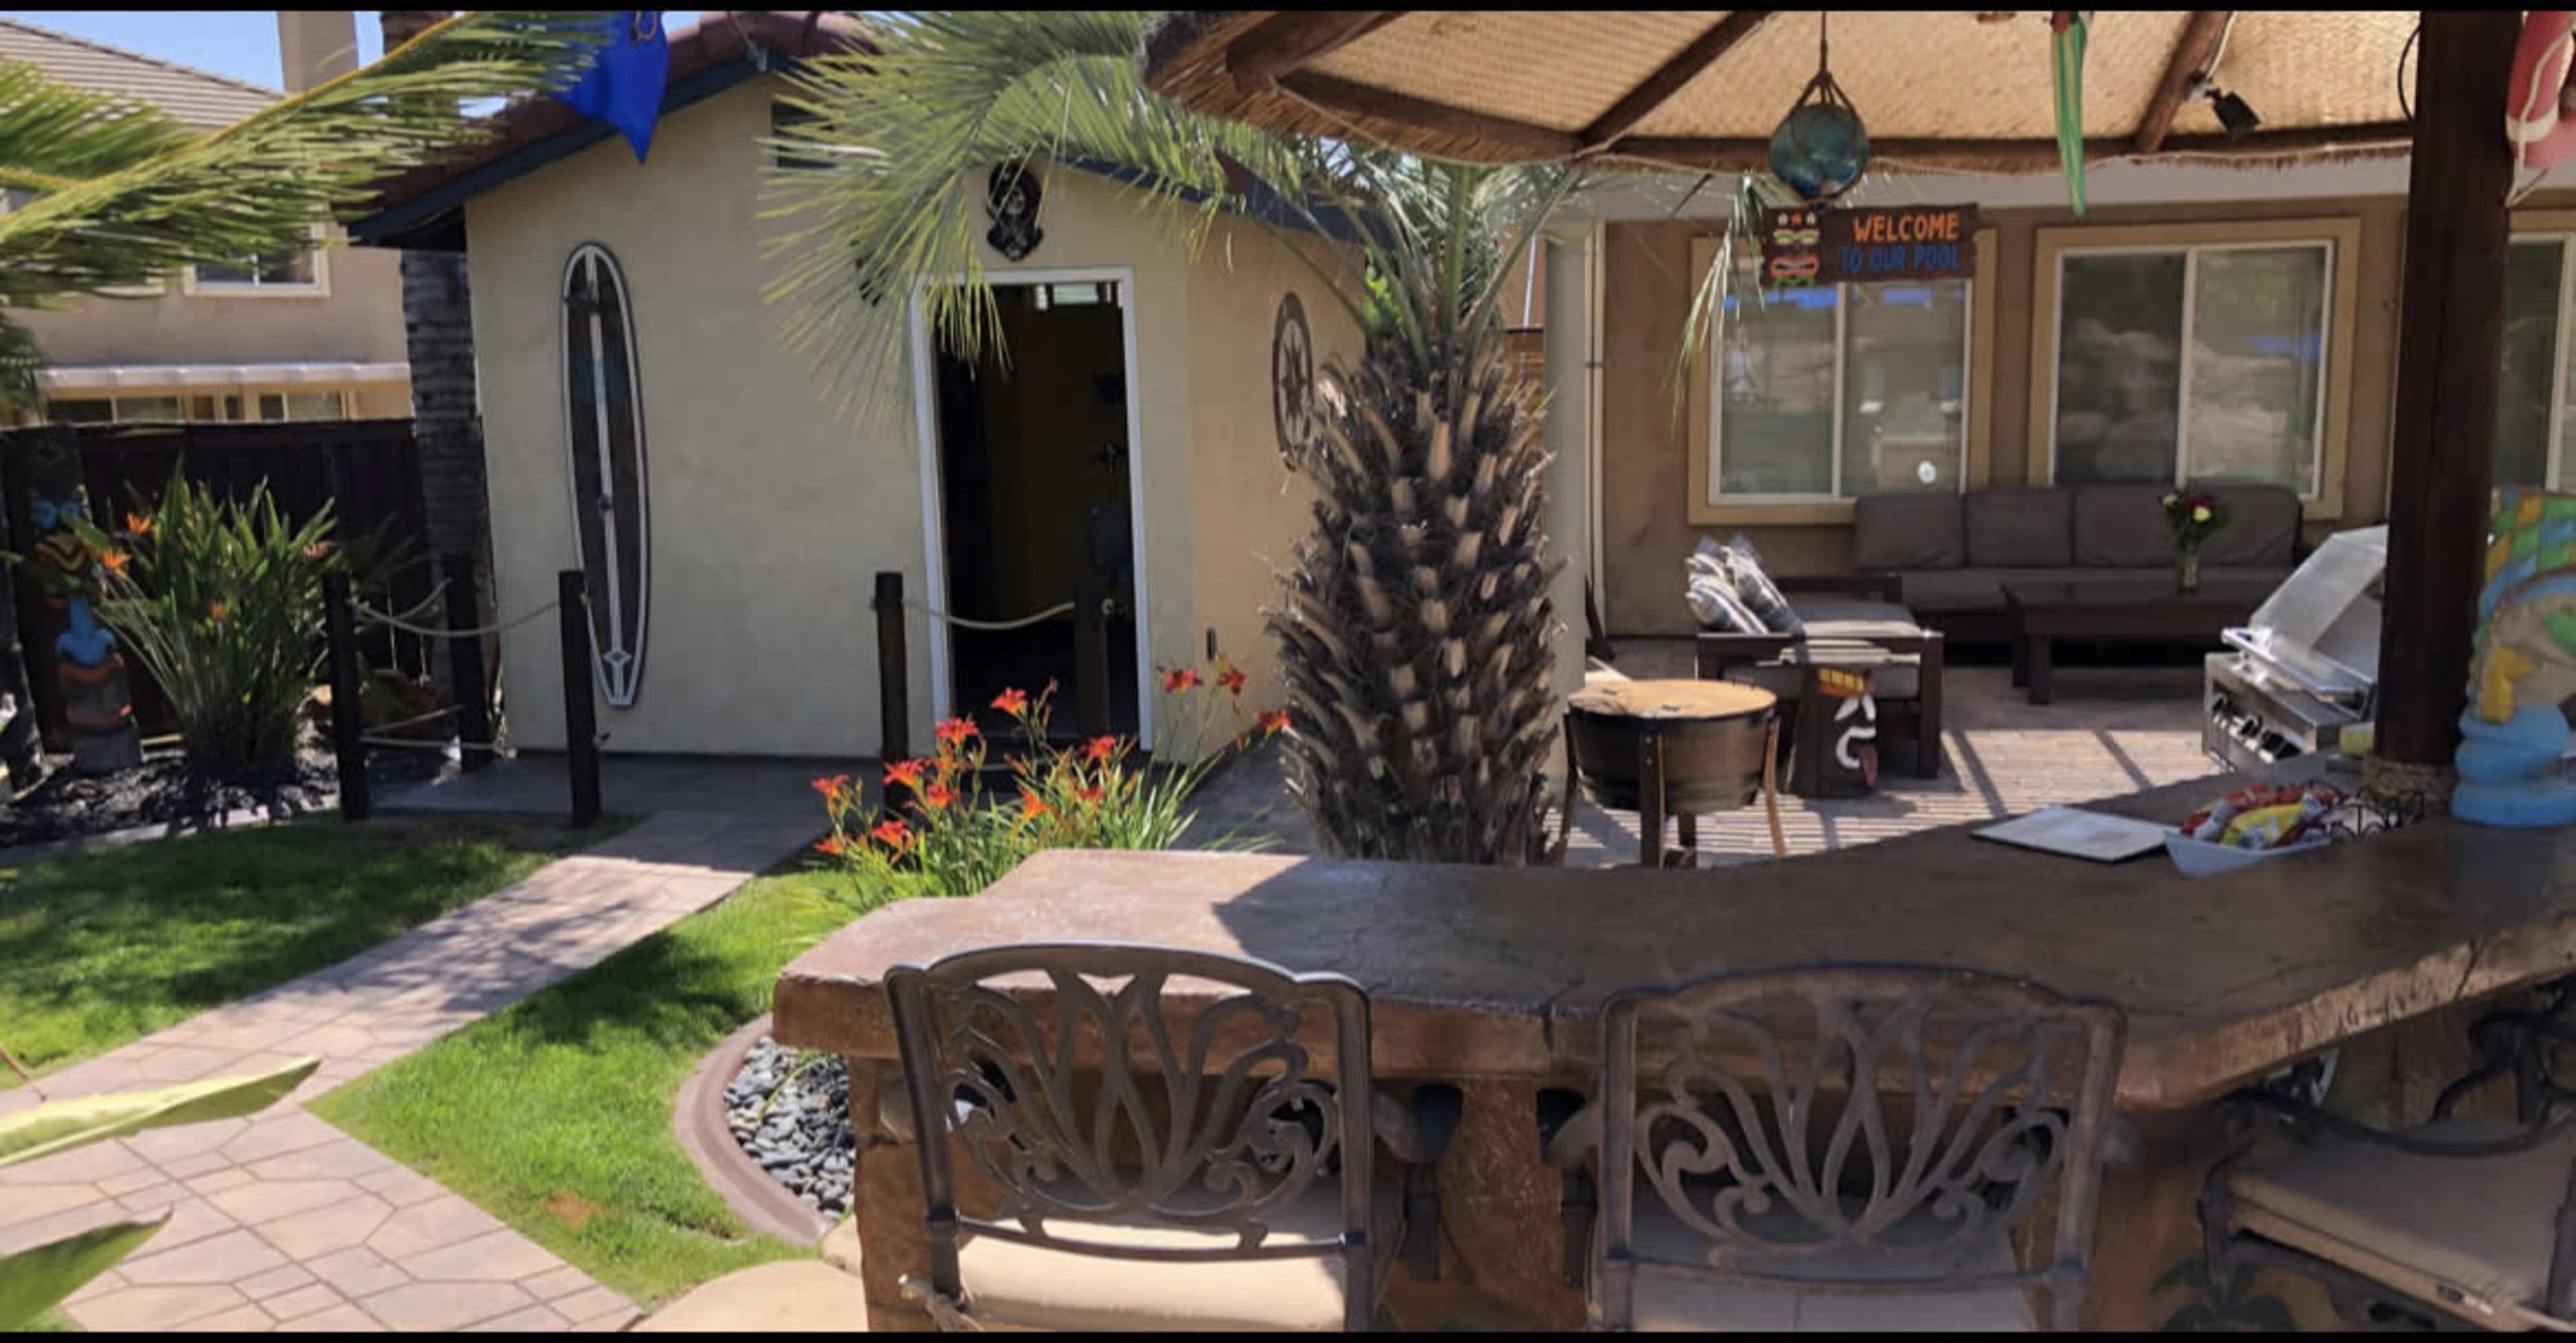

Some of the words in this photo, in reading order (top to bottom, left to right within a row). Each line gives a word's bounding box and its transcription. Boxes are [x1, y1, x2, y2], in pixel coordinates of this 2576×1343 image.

[1854, 211, 1960, 242] WELCOME
[1840, 246, 1863, 274] TO
[1870, 245, 1906, 272] OUR
[1915, 244, 1959, 270] POOL
